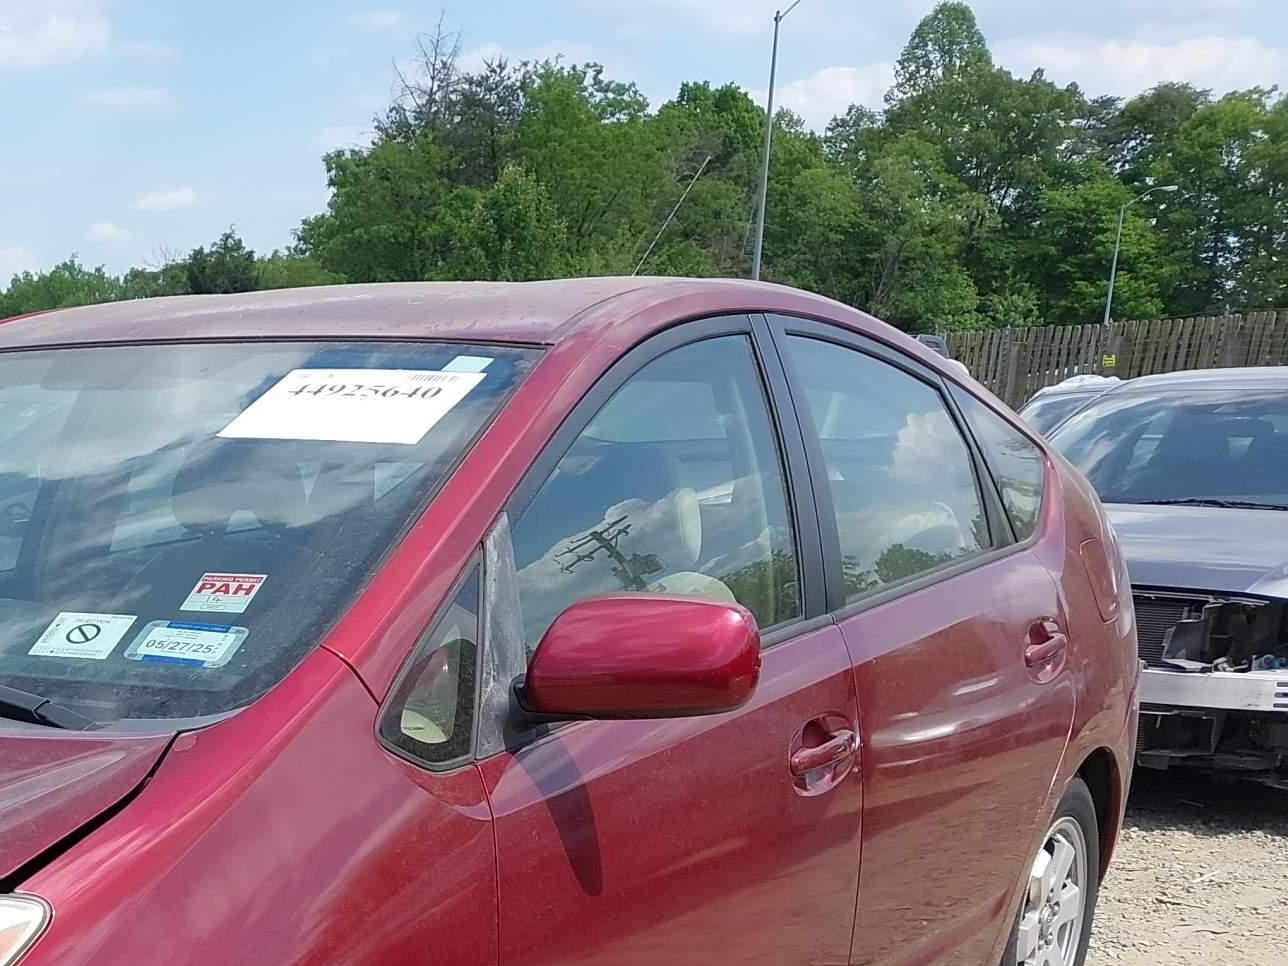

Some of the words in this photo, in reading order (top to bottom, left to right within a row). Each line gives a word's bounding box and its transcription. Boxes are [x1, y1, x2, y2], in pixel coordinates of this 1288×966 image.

[288, 383, 443, 399] 44925640
[194, 582, 256, 596] PAH
[145, 638, 213, 655] 05/27/25
